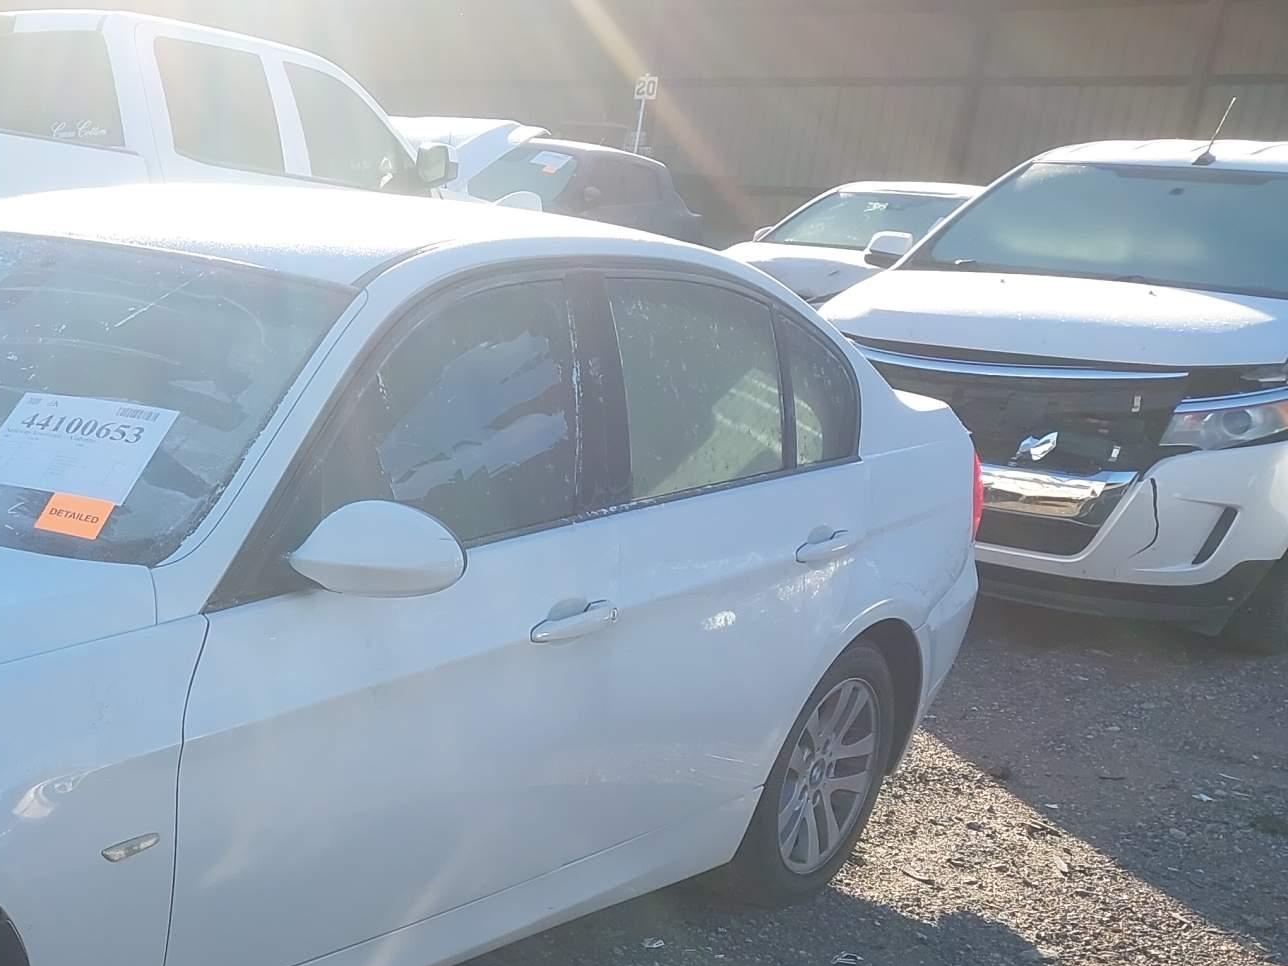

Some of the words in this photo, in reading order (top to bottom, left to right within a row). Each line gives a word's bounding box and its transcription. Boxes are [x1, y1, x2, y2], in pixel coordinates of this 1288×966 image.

[636, 80, 656, 96] 20
[20, 412, 145, 445] 44100653
[48, 507, 100, 525] DETAILED
